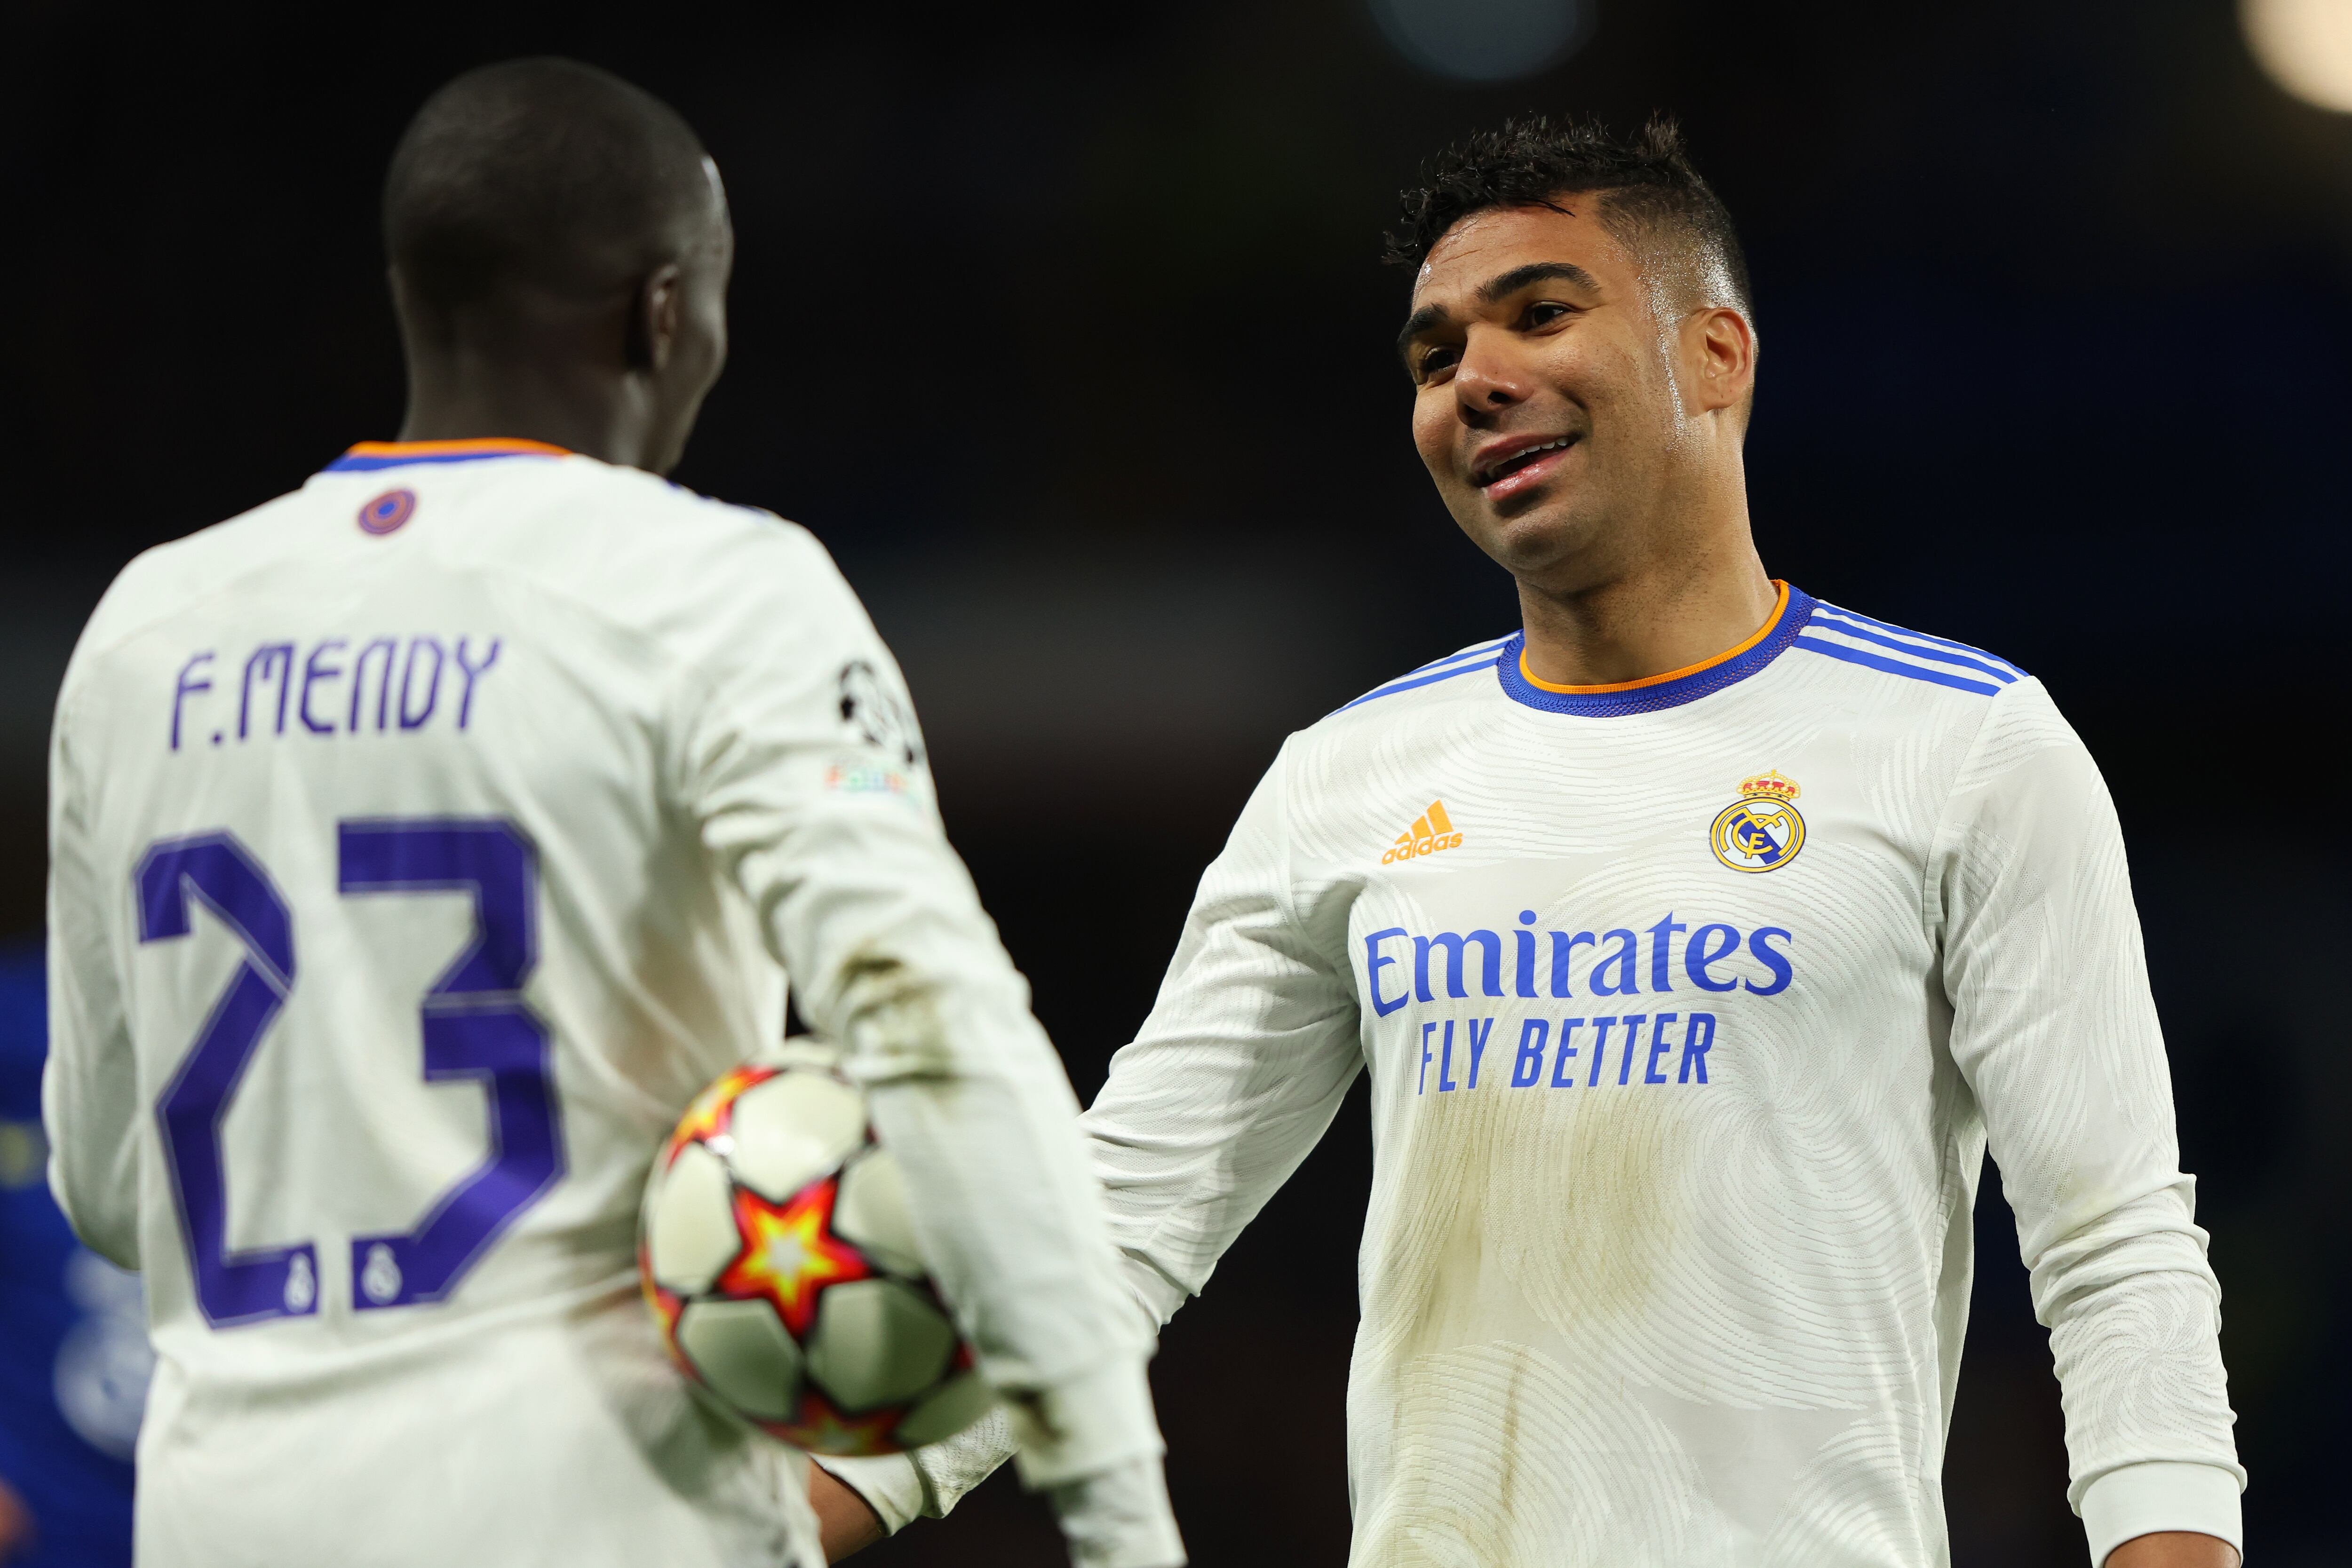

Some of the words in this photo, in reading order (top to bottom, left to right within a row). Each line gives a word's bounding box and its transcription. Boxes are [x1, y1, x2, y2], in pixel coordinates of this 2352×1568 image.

[169, 636, 502, 752] F.MENDY
[1381, 832, 1464, 865] adidas
[1364, 910, 1793, 1018] Emirates
[132, 814, 570, 1332] 23
[1418, 1017, 1494, 1095] FLY
[1510, 1012, 1716, 1089] BETTER
